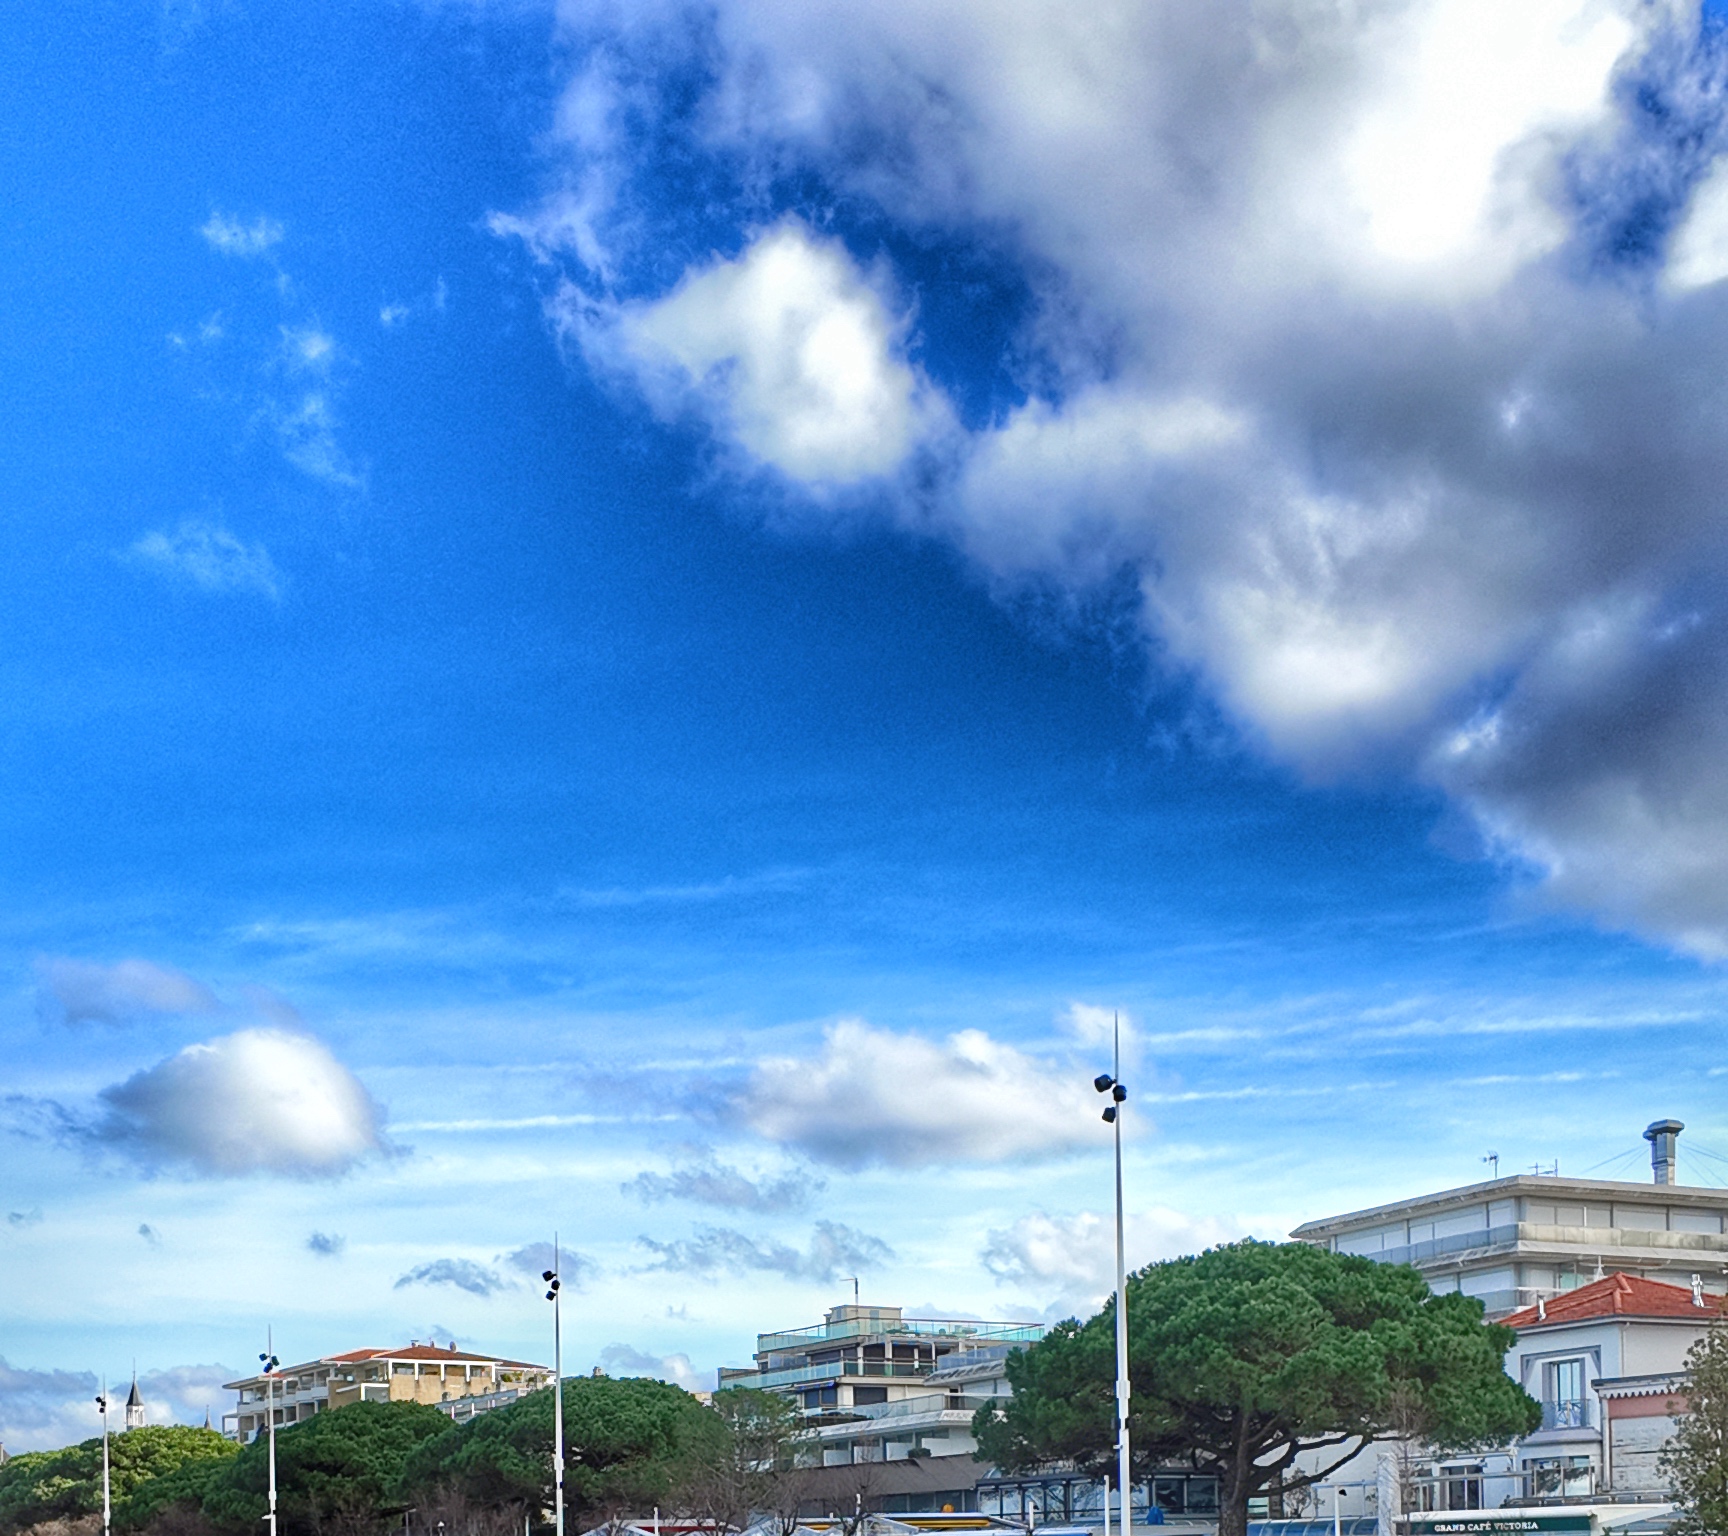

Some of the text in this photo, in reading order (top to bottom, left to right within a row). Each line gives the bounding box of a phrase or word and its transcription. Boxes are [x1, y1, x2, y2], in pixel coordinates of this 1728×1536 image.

[1434, 1521, 1538, 1532] GRAND CAFÉ VICTORIA
